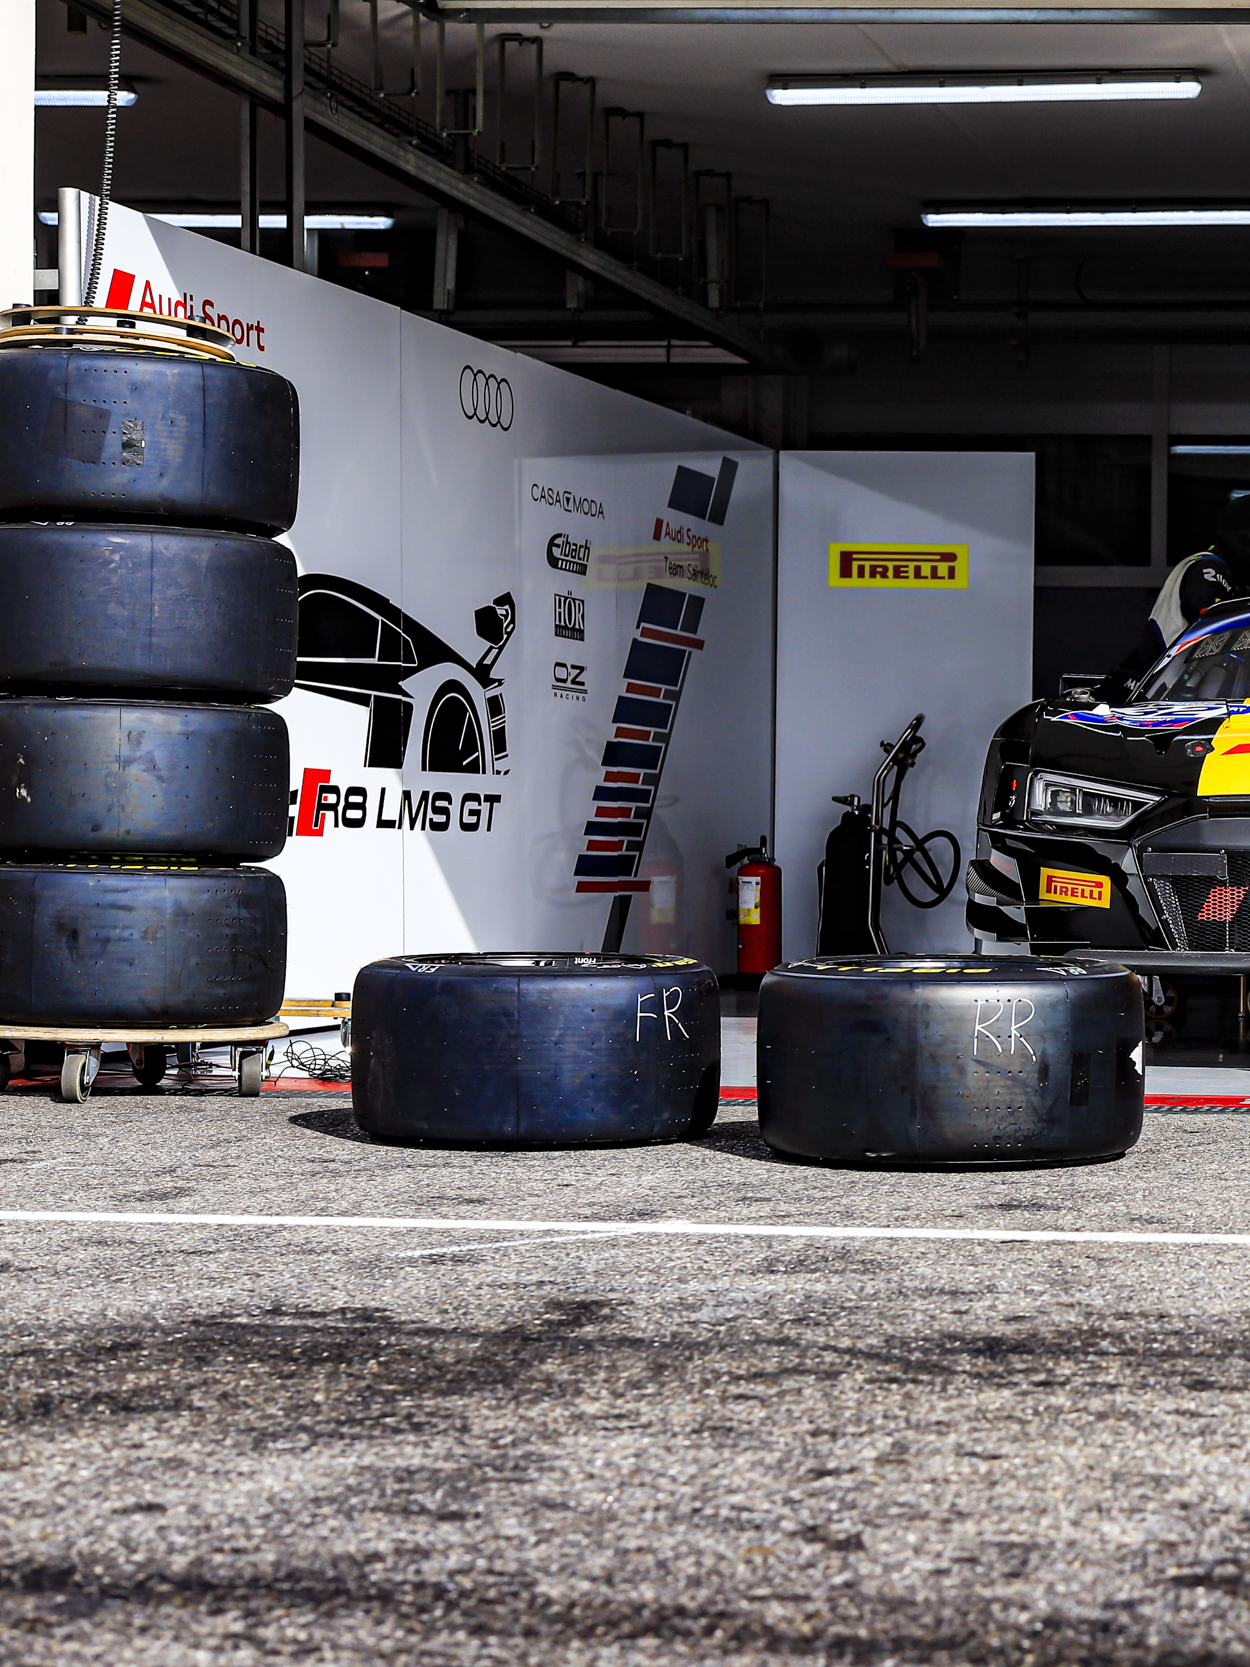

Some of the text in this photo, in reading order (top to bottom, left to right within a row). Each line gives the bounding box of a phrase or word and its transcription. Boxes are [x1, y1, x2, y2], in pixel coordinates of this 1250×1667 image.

[139, 279, 266, 351] Audi Sport
[547, 533, 591, 576] Eibach
[664, 521, 710, 553] Audi Sport
[664, 556, 684, 578] Team
[839, 550, 958, 580] PIRELLI
[553, 691, 587, 703] RACING
[313, 784, 502, 832] R8 LMS GT
[1046, 874, 1104, 901] PIRELLI
[635, 986, 690, 1042] FR
[973, 998, 1037, 1063] RR
